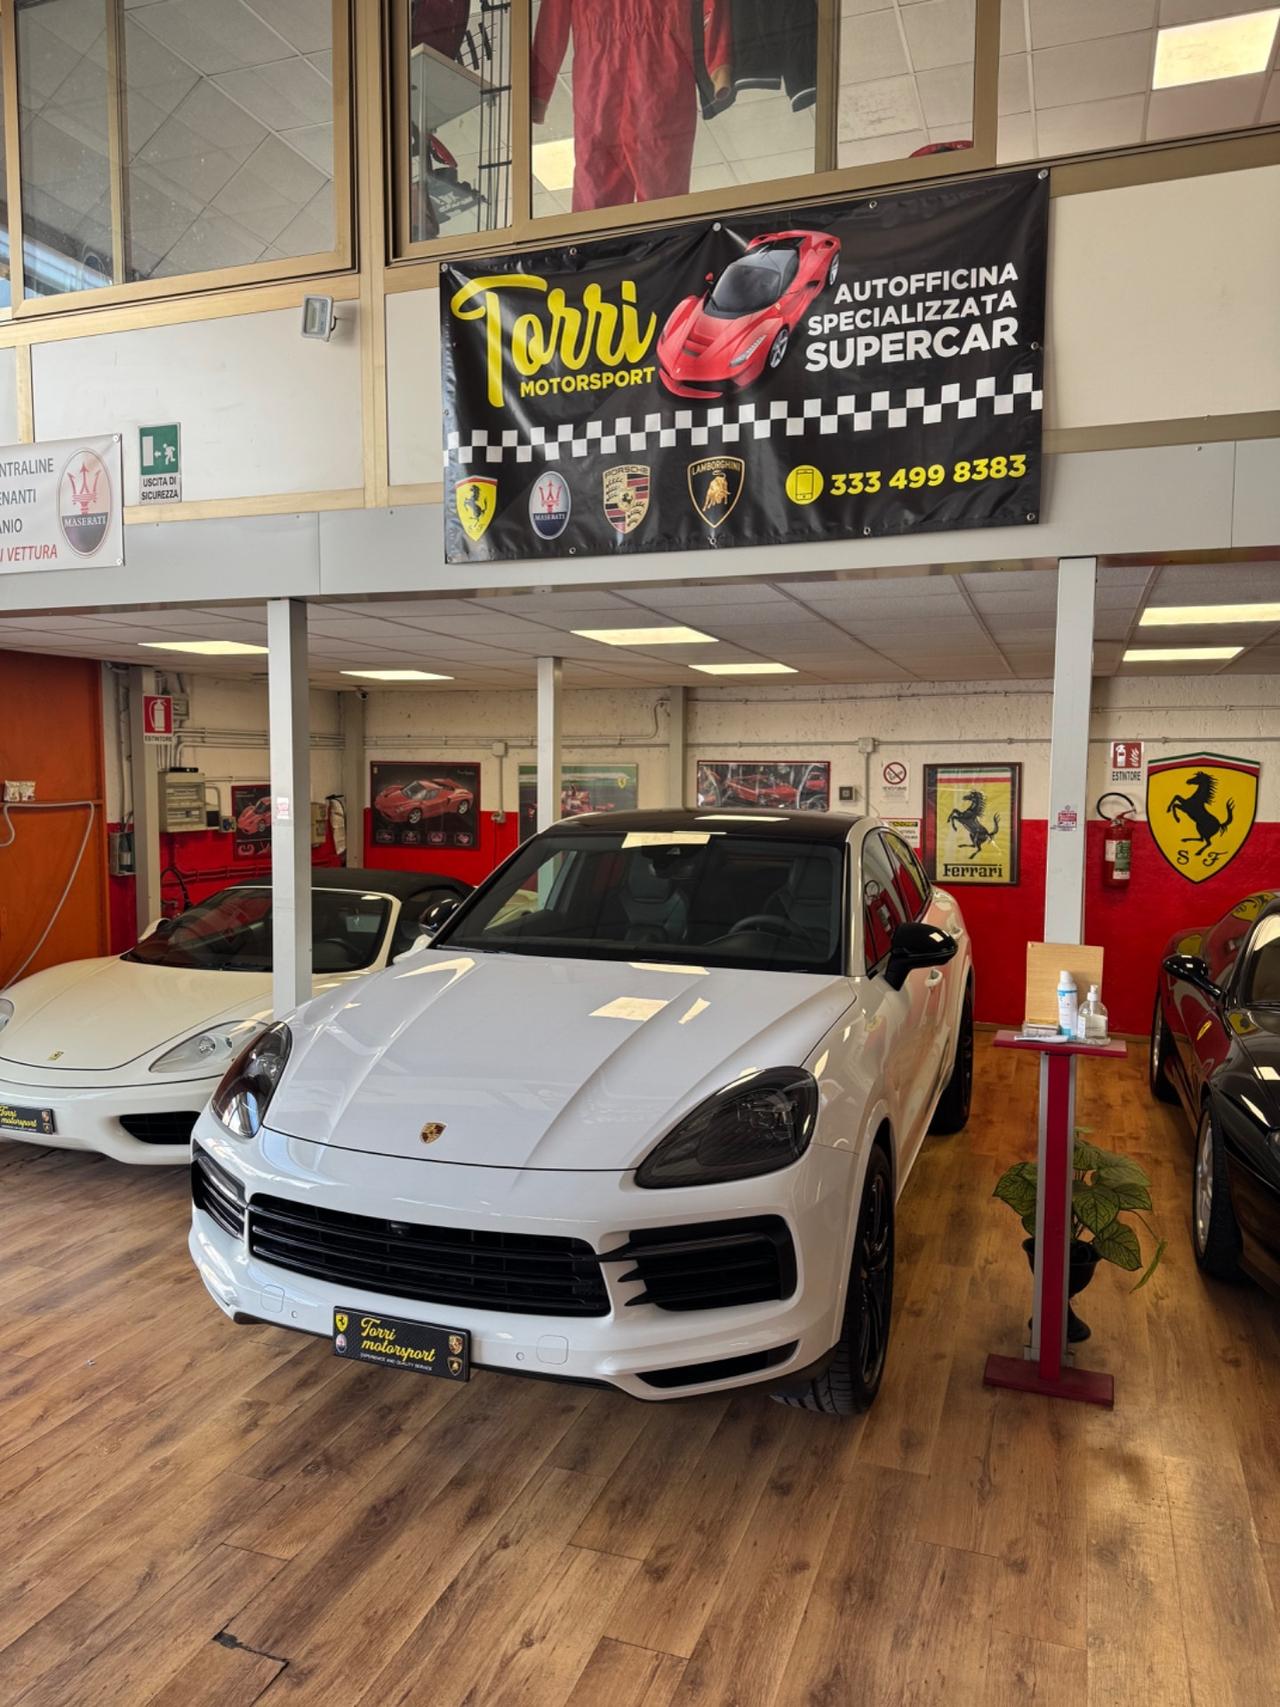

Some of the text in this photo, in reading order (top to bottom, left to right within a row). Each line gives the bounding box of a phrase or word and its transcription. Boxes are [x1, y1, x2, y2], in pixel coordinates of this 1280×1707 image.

[834, 262, 1019, 305] AUTOFFICINA
[807, 290, 1018, 336] SPECIALIZZATA
[451, 274, 657, 408] Torri
[805, 316, 1019, 372] SUPERCAR
[520, 367, 656, 398] MOTORSPORT
[604, 465, 649, 479] PORSCHE
[691, 460, 741, 475] LAMBORGHINI
[830, 454, 1027, 496] 333 499 8383
[143, 476, 177, 488] USCITA DI
[141, 490, 179, 500] SICUREZZA
[64, 515, 107, 527] MASERATI
[7, 544, 58, 562] VETTURA
[1112, 771, 1141, 781] ESTINTORE
[943, 863, 1003, 878] Ferrari
[360, 1317, 396, 1340] Torri
[361, 1340, 436, 1362] motorsport
